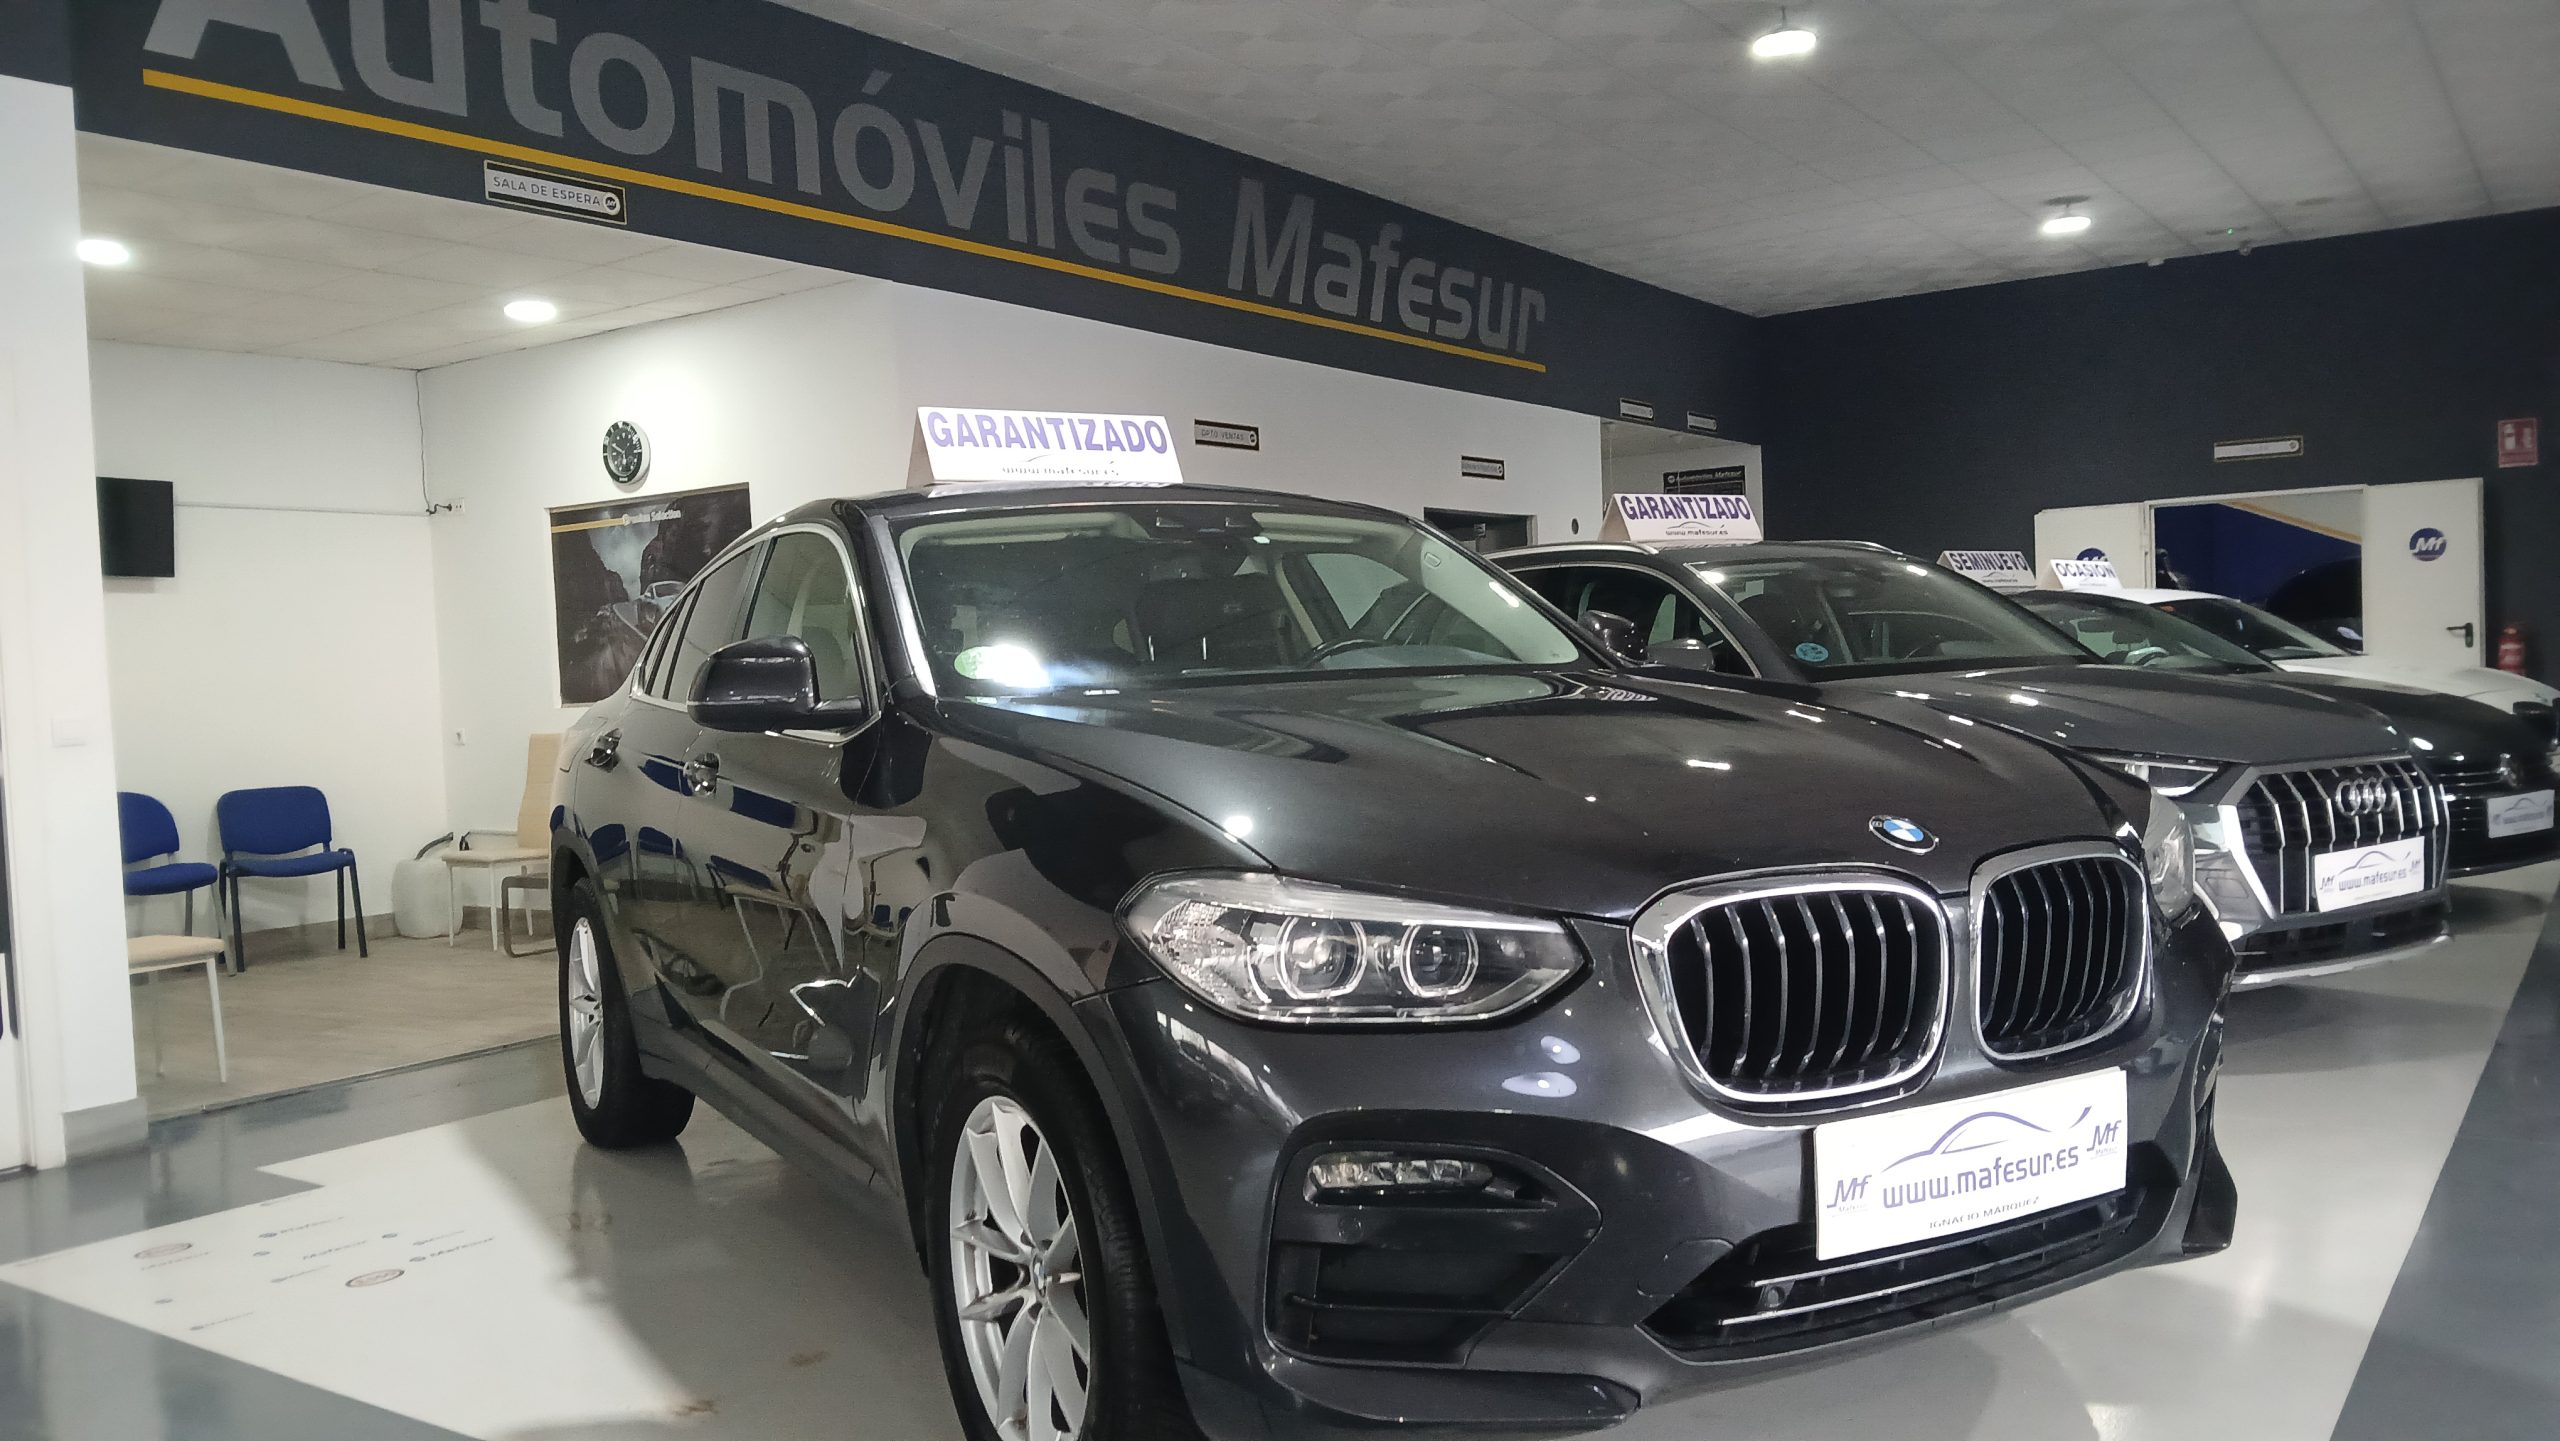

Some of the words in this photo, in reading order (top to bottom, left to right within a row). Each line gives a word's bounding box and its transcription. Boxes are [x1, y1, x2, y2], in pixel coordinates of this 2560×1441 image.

[493, 176, 527, 192] SALA
[531, 183, 548, 197] DE
[552, 187, 601, 206] ESPERA
[1228, 177, 1546, 354] Mafesur
[926, 411, 1168, 455] GARANTIZADO
[1619, 496, 1751, 520] GARANTIZADO
[1950, 552, 2029, 571] SEMINUEVO
[2338, 868, 2407, 892] www.mafesur.es
[1882, 1146, 2079, 1209] www.mafesur.es
[1929, 1211, 1980, 1229] IGNACIO
